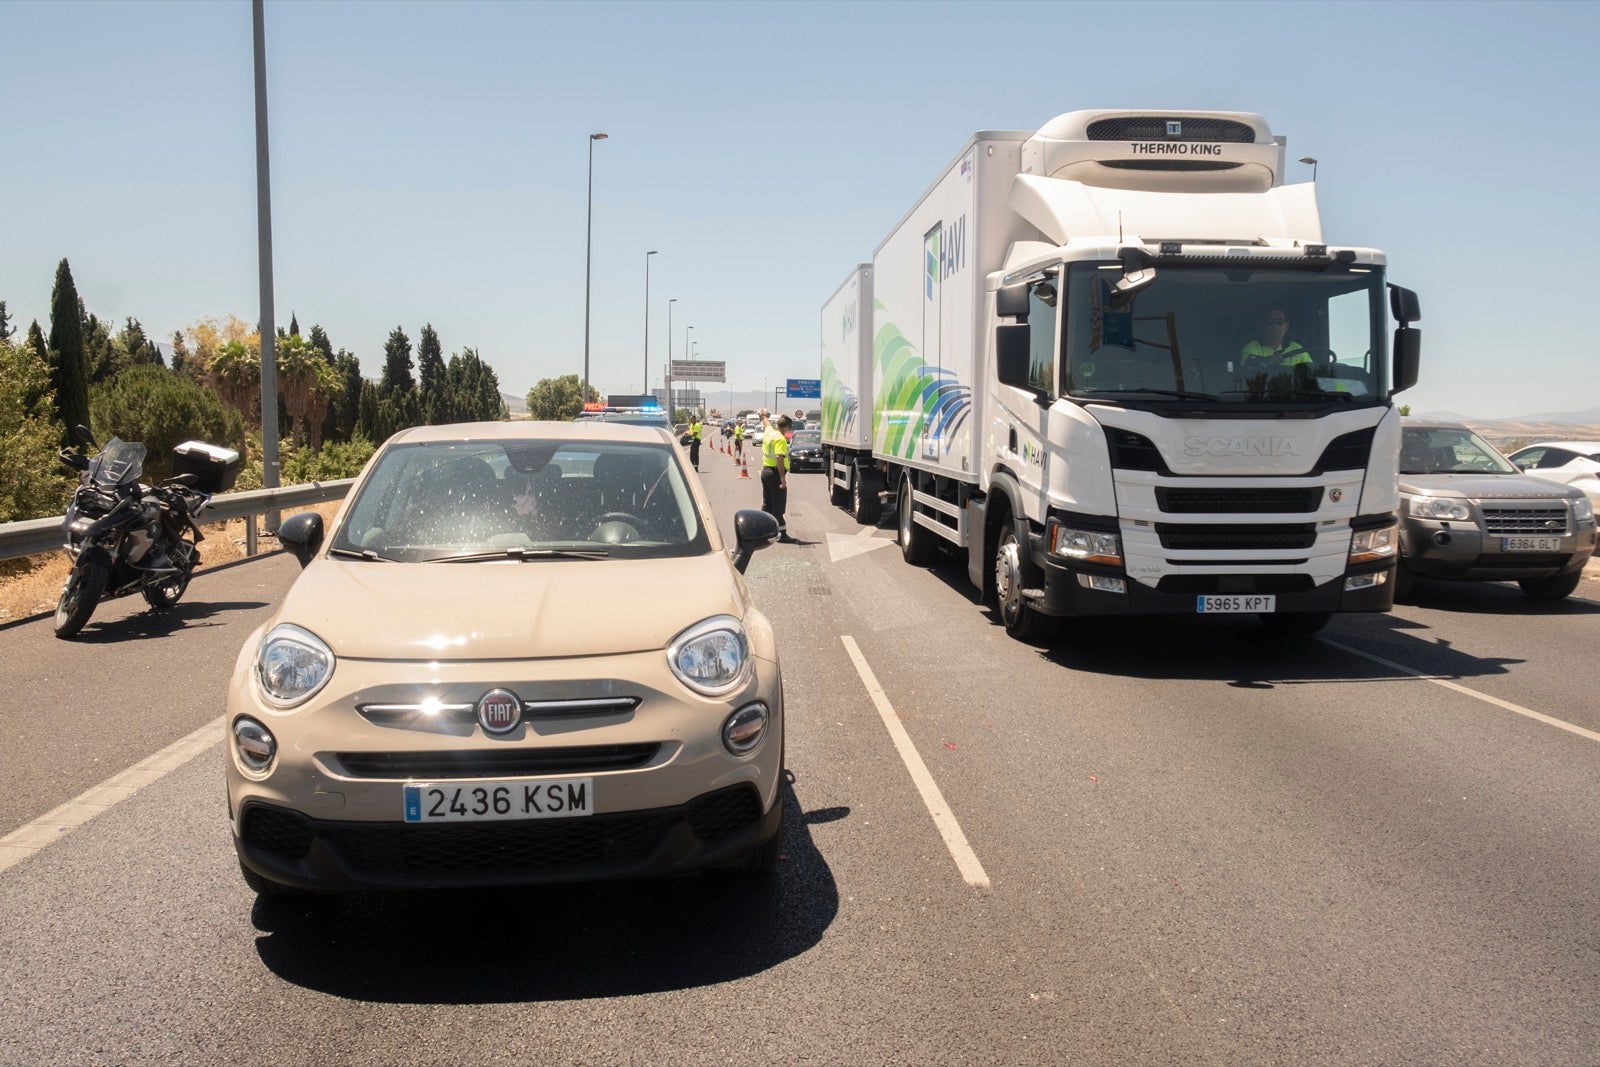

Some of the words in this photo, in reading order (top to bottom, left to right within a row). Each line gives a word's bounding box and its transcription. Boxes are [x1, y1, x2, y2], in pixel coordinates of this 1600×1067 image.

[1131, 143, 1187, 154] THERMO
[1190, 144, 1222, 155] KING
[940, 213, 966, 281] HAVI
[1184, 435, 1300, 457] SCANIA
[1031, 446, 1048, 471] HAVI
[1538, 539, 1558, 549] GLT
[1206, 597, 1240, 611] 5965
[1245, 597, 1271, 610] KPT
[488, 703, 512, 722] FIAT
[428, 787, 511, 817] 2436
[524, 783, 586, 813] KSM
